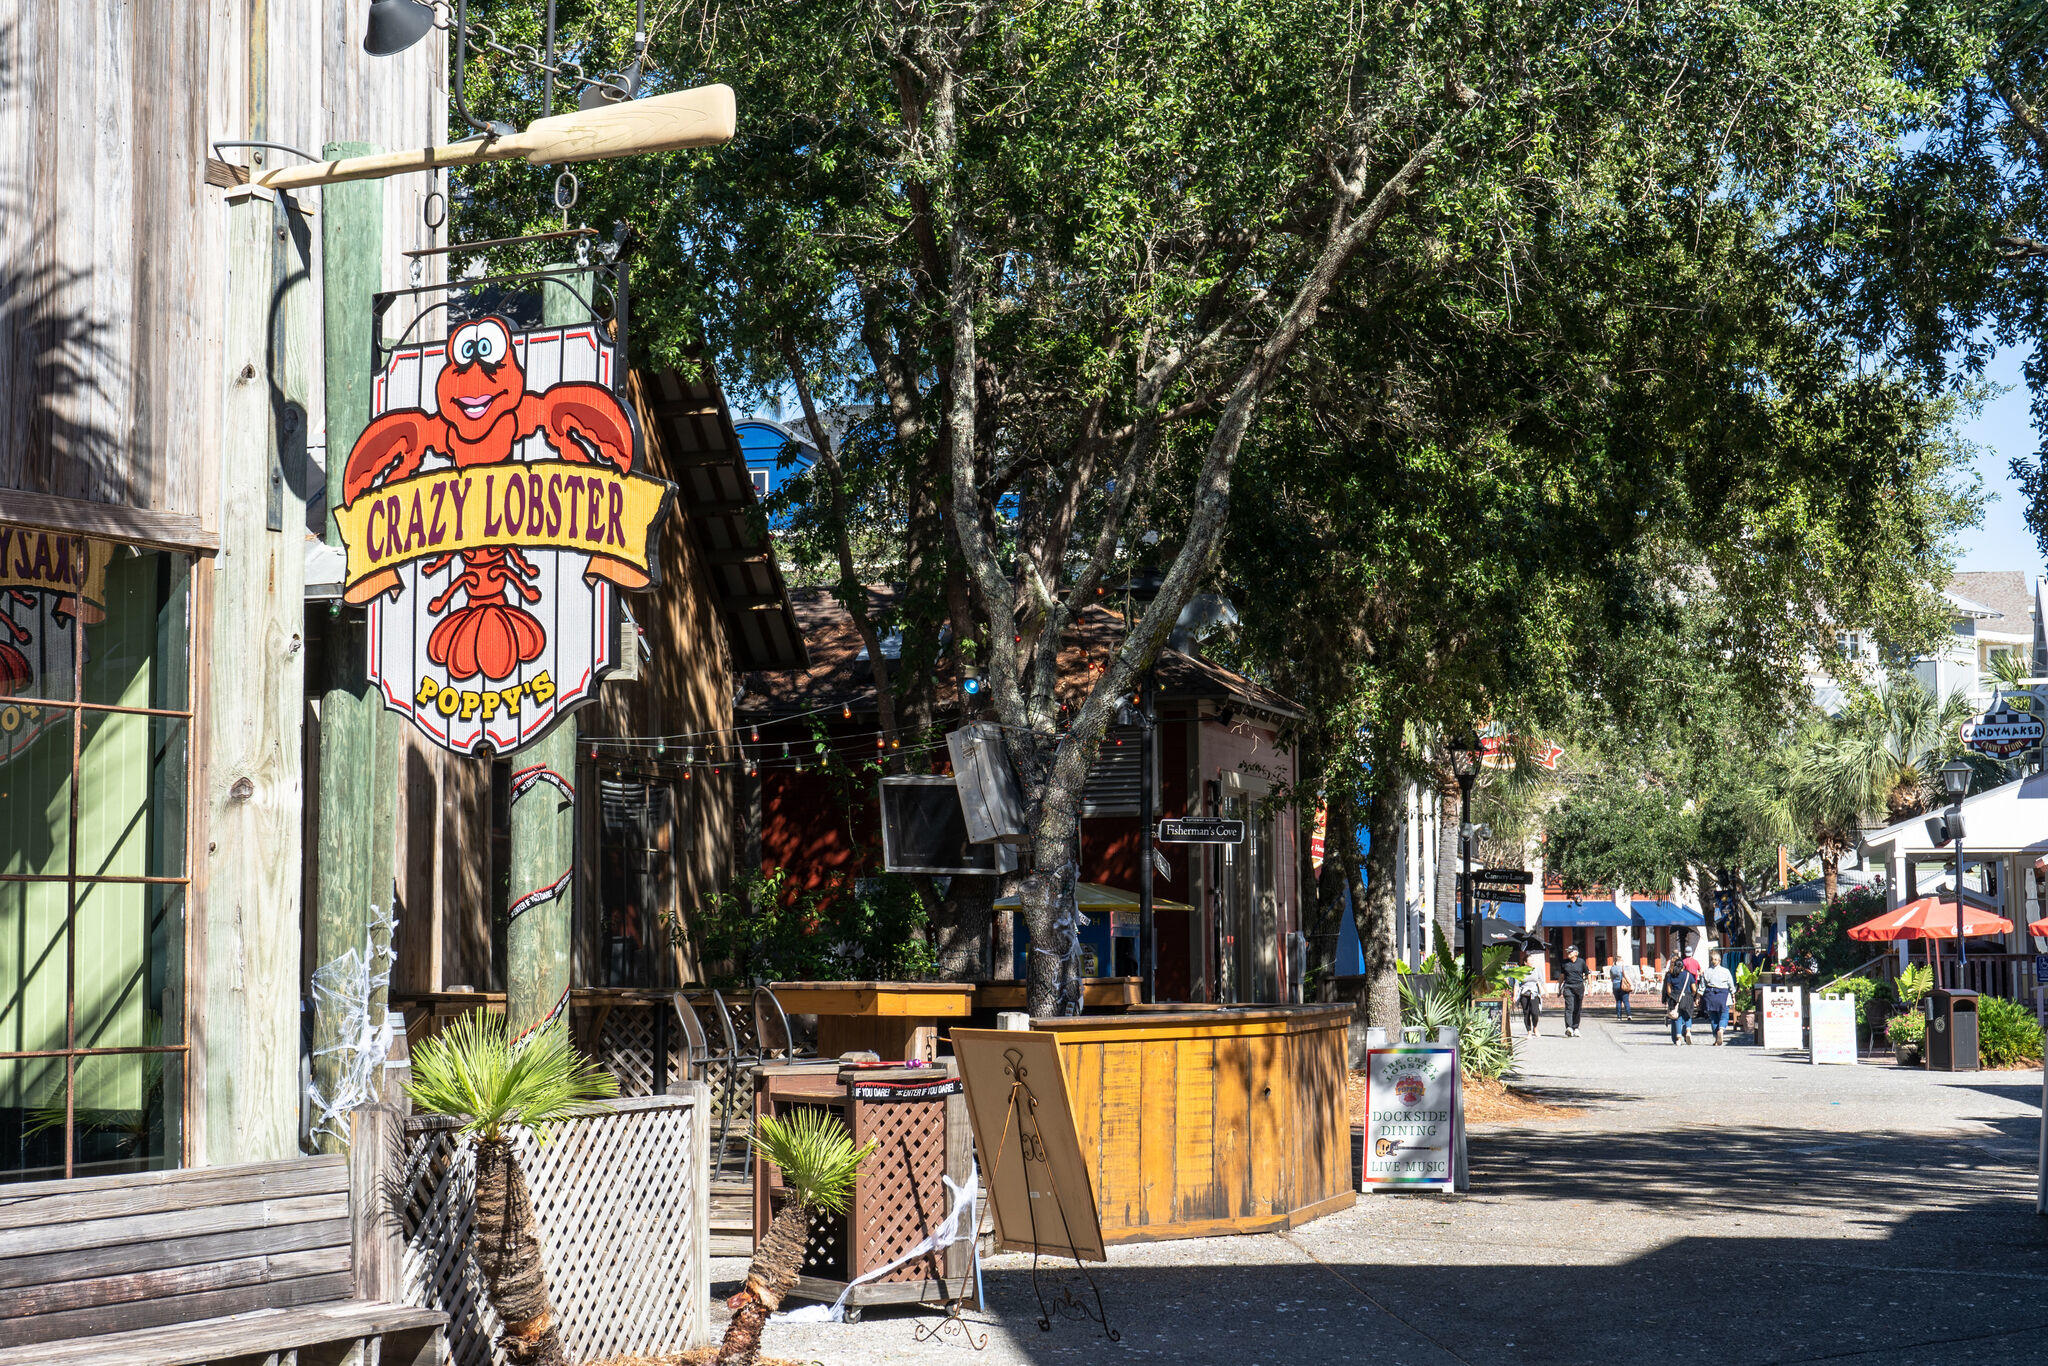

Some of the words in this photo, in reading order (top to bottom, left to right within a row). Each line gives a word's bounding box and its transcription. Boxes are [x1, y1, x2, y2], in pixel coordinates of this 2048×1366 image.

[366, 475, 473, 564] CRAZY
[483, 471, 627, 549] LOBSTER
[415, 669, 557, 722] POPPY'S
[1963, 726, 2041, 738] CANDYMAKER
[1981, 740, 2001, 753] CANDY
[1166, 824, 1215, 836] Fisherman's
[1216, 825, 1237, 836] Cove
[1382, 1058, 1402, 1075] THE
[856, 1088, 862, 1097] IF
[862, 1088, 873, 1097] YOU
[874, 1088, 890, 1097] DARE!
[903, 1089, 921, 1097] ENTER
[921, 1088, 928, 1096] IF
[928, 1086, 938, 1095] YOU
[938, 1083, 954, 1093] DARE!
[1372, 1111, 1448, 1122] DOCKSIDE
[1382, 1125, 1437, 1136] DINING
[1372, 1161, 1400, 1172] LIVE
[1405, 1161, 1445, 1172] MUSIC
